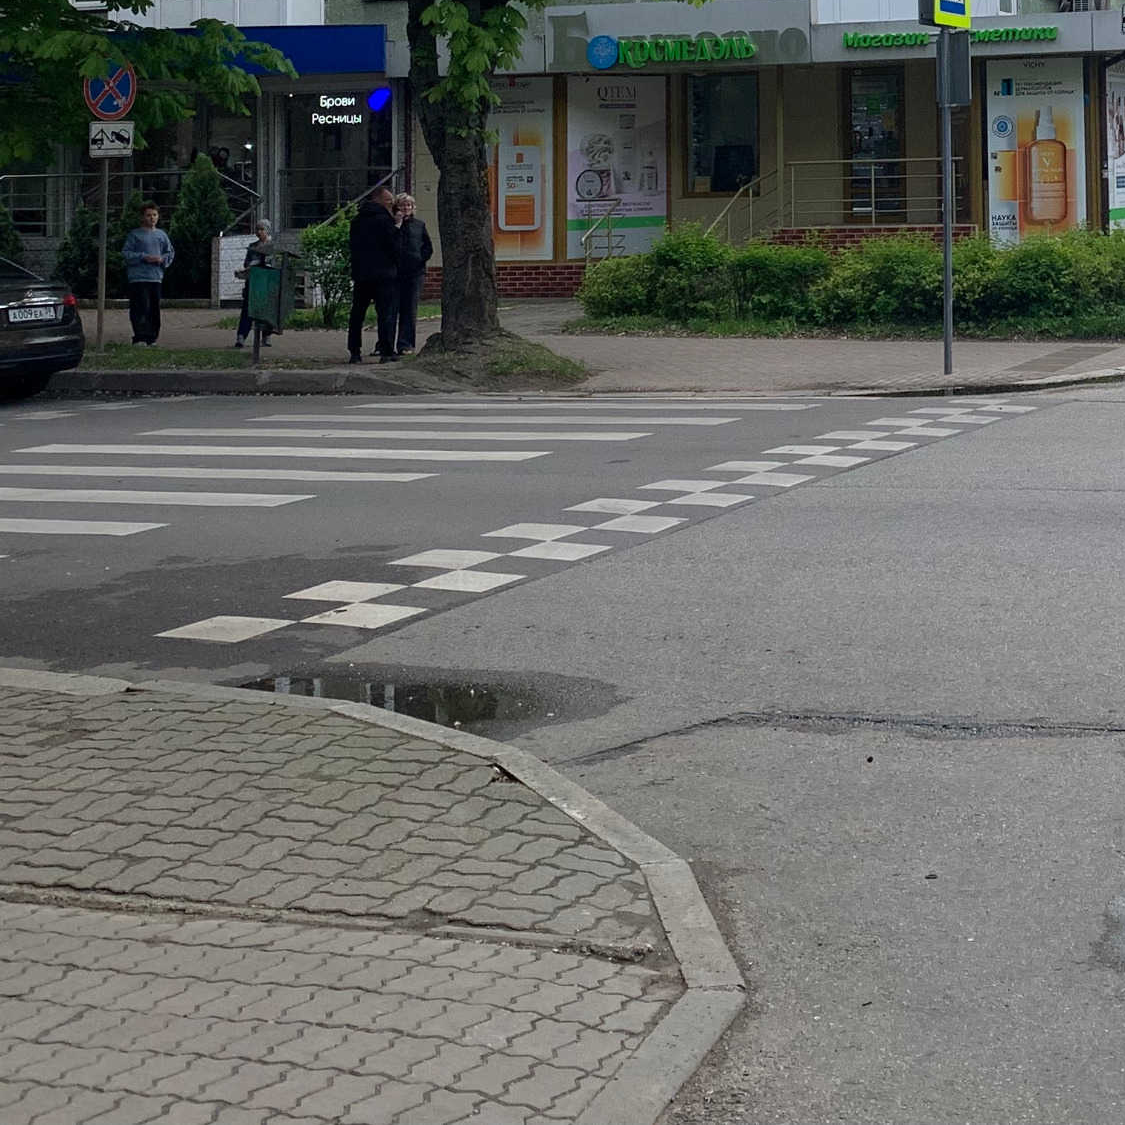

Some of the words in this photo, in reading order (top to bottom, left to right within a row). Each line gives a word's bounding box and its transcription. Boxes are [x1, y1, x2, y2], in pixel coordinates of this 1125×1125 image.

[842, 31, 930, 49] Магазин
[618, 35, 758, 69] КОСМЕДЭЛЬ
[1022, 61, 1046, 69] VICHY
[596, 86, 637, 102] QTEM
[319, 95, 356, 109] Брови
[311, 112, 362, 124] Ресницы
